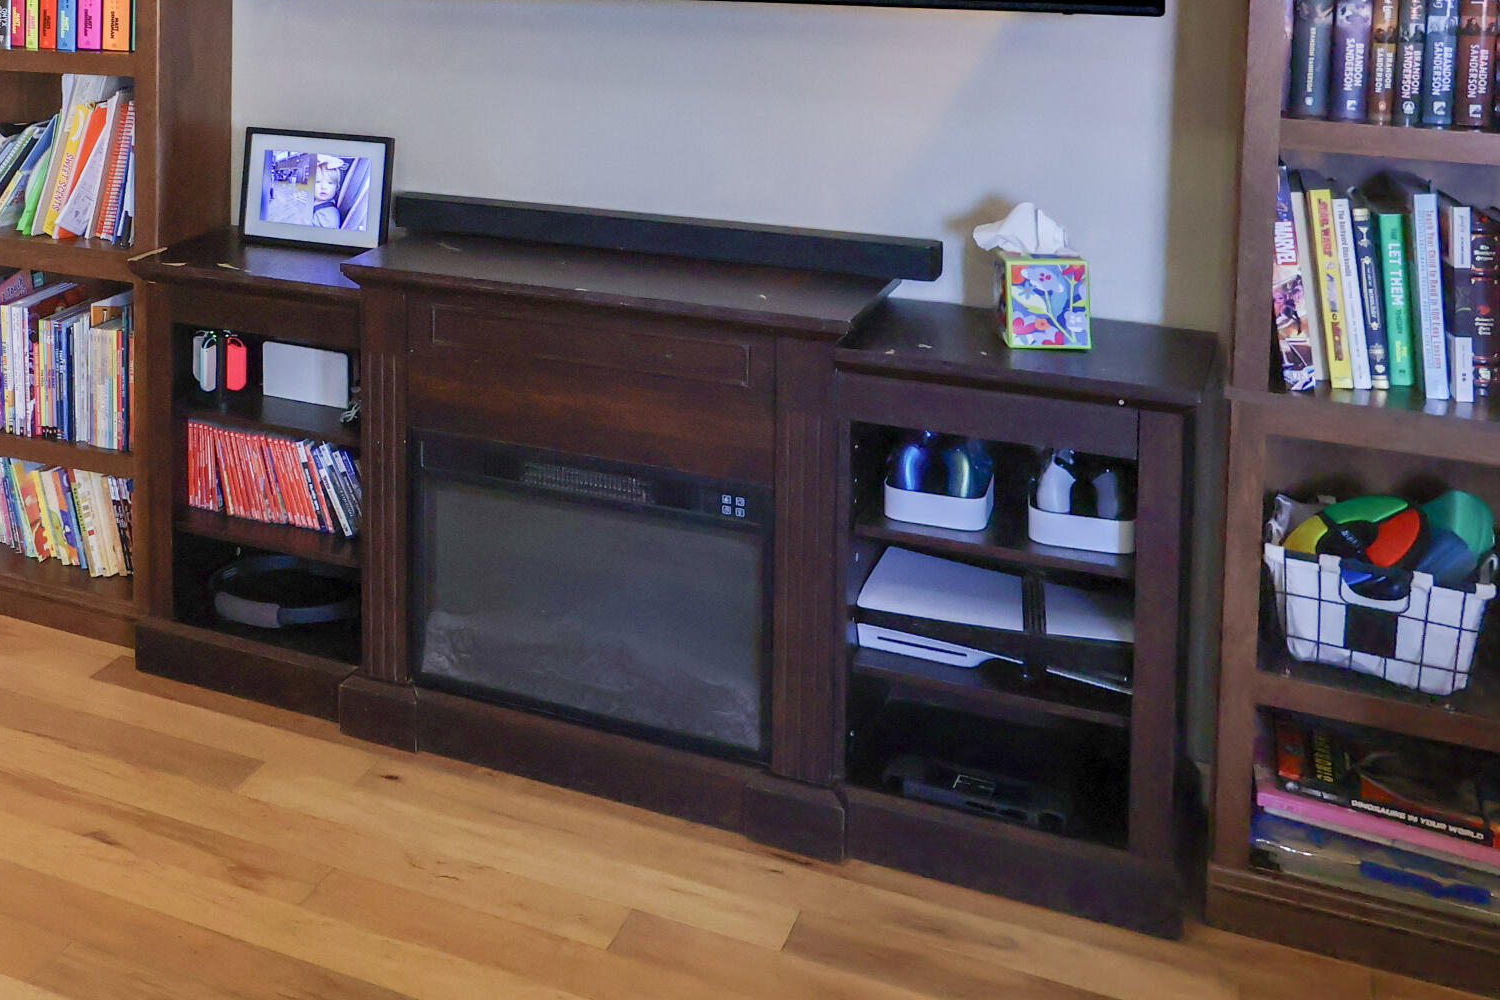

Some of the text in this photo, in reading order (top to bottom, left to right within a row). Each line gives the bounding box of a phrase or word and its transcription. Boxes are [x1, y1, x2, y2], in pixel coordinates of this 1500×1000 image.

[1344, 38, 1357, 91] SANDERSON
[1353, 43, 1364, 87] BRANDON
[1375, 48, 1385, 93] SANDERSON
[1384, 53, 1394, 89] BRANDON
[1401, 44, 1414, 98] SANDERSON
[1411, 50, 1422, 94] BRANDON
[1431, 41, 1443, 95] SANDERSON
[1441, 46, 1453, 91] BRANDON
[1467, 44, 1479, 98] SANDERSON
[1478, 49, 1490, 94] BRANDON
[52, 153, 74, 212] SWEET SCENTS
[1426, 210, 1436, 230] Teach
[1426, 232, 1437, 249] Your
[1274, 221, 1297, 265] MARVEL
[1388, 243, 1401, 266] LET
[1427, 250, 1438, 268] Child
[1390, 269, 1404, 305] THEM
[1428, 269, 1437, 277] to
[1428, 279, 1440, 297] Read
[1430, 321, 1442, 338] Easy
[1431, 340, 1443, 370] Lessons
[1350, 799, 1406, 821] DINOSAURS
[1419, 816, 1447, 832] YOUR
[1448, 824, 1485, 841] WORLD
